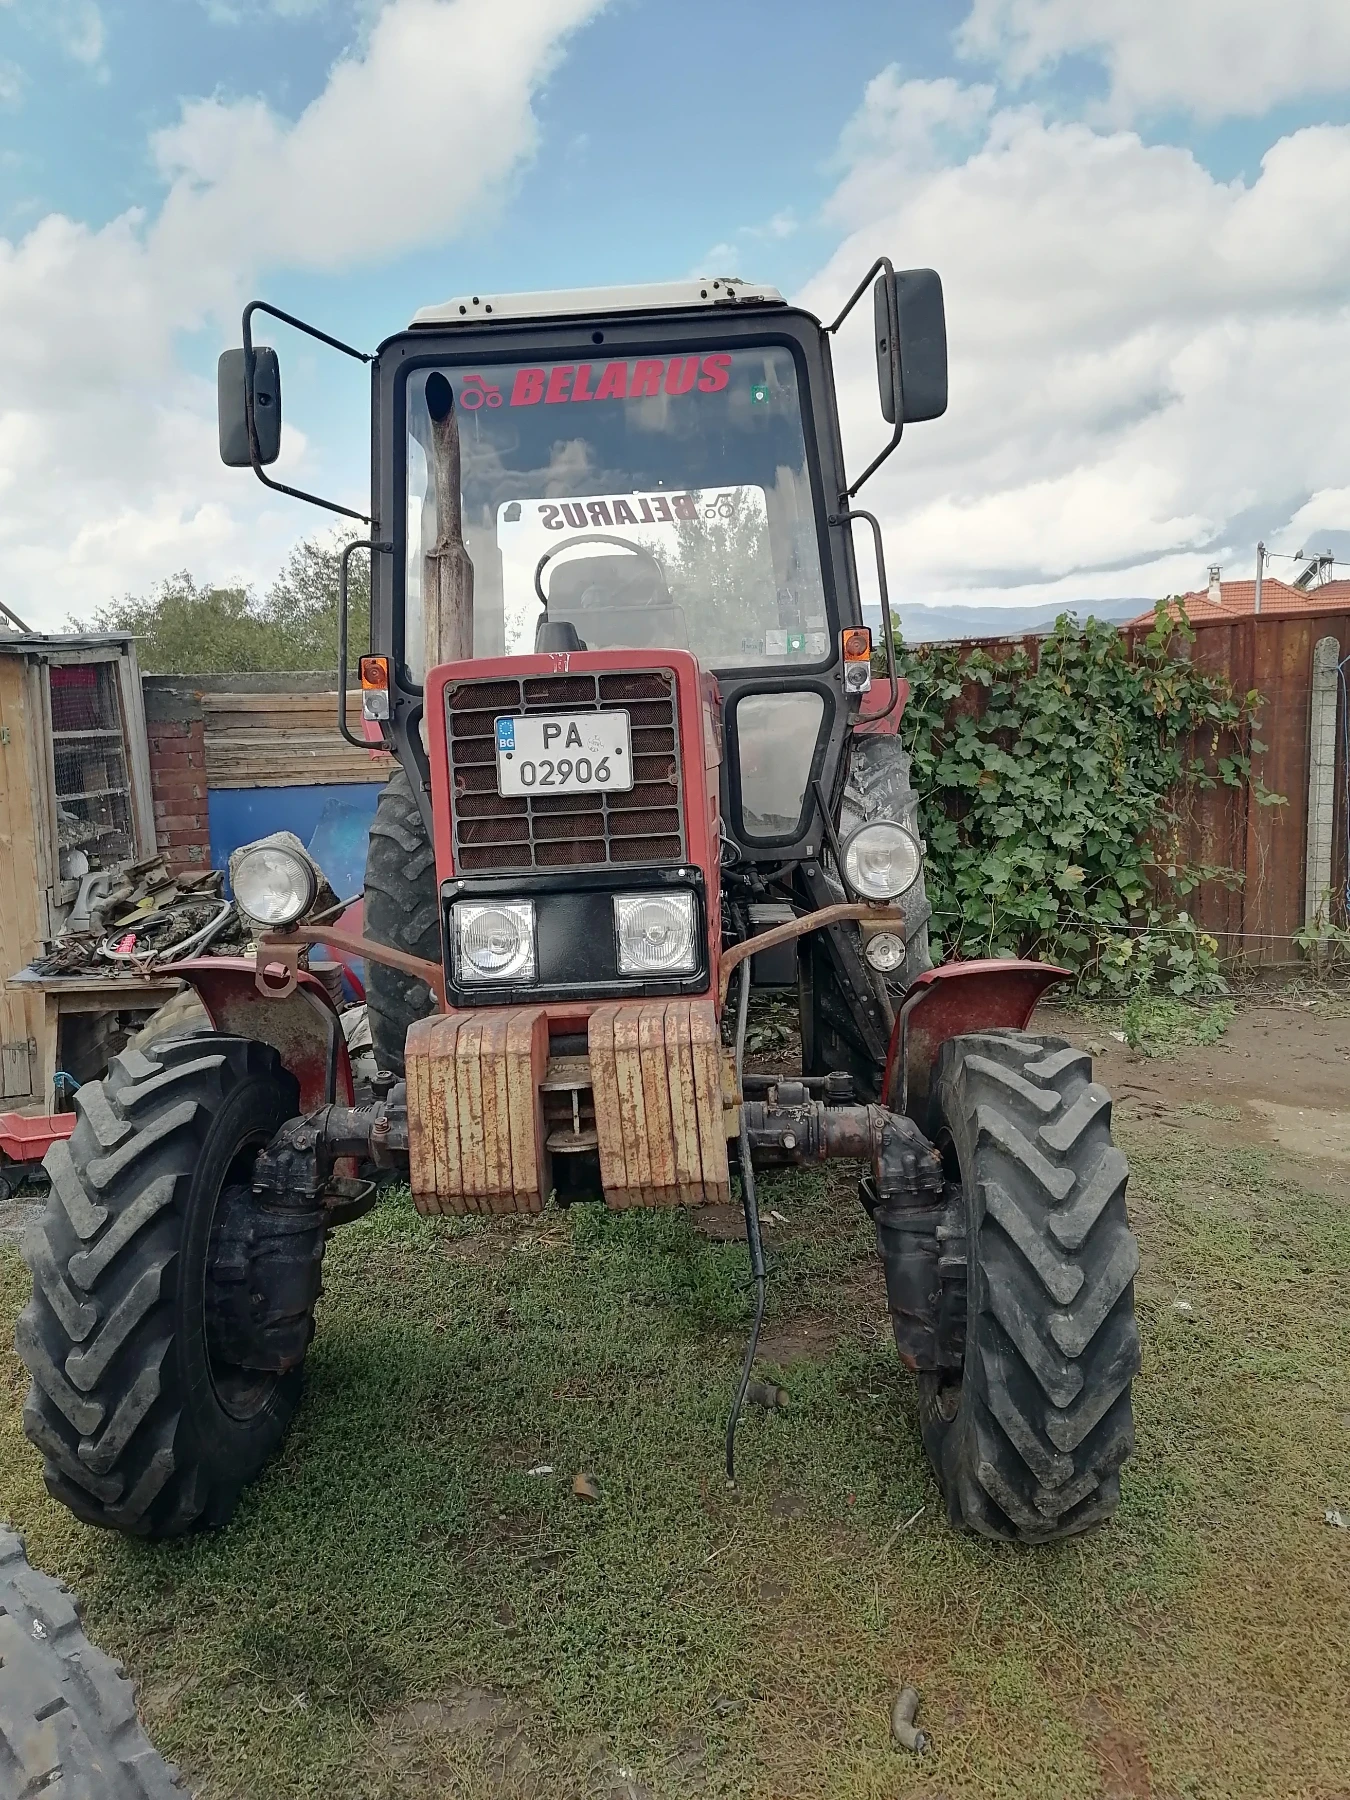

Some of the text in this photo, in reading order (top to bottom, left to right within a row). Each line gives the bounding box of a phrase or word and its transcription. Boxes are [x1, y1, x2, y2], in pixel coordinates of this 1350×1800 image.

[510, 353, 732, 407] BELARUS
[499, 738, 515, 748] BG
[543, 722, 583, 750] PA
[520, 756, 610, 786] 02906
